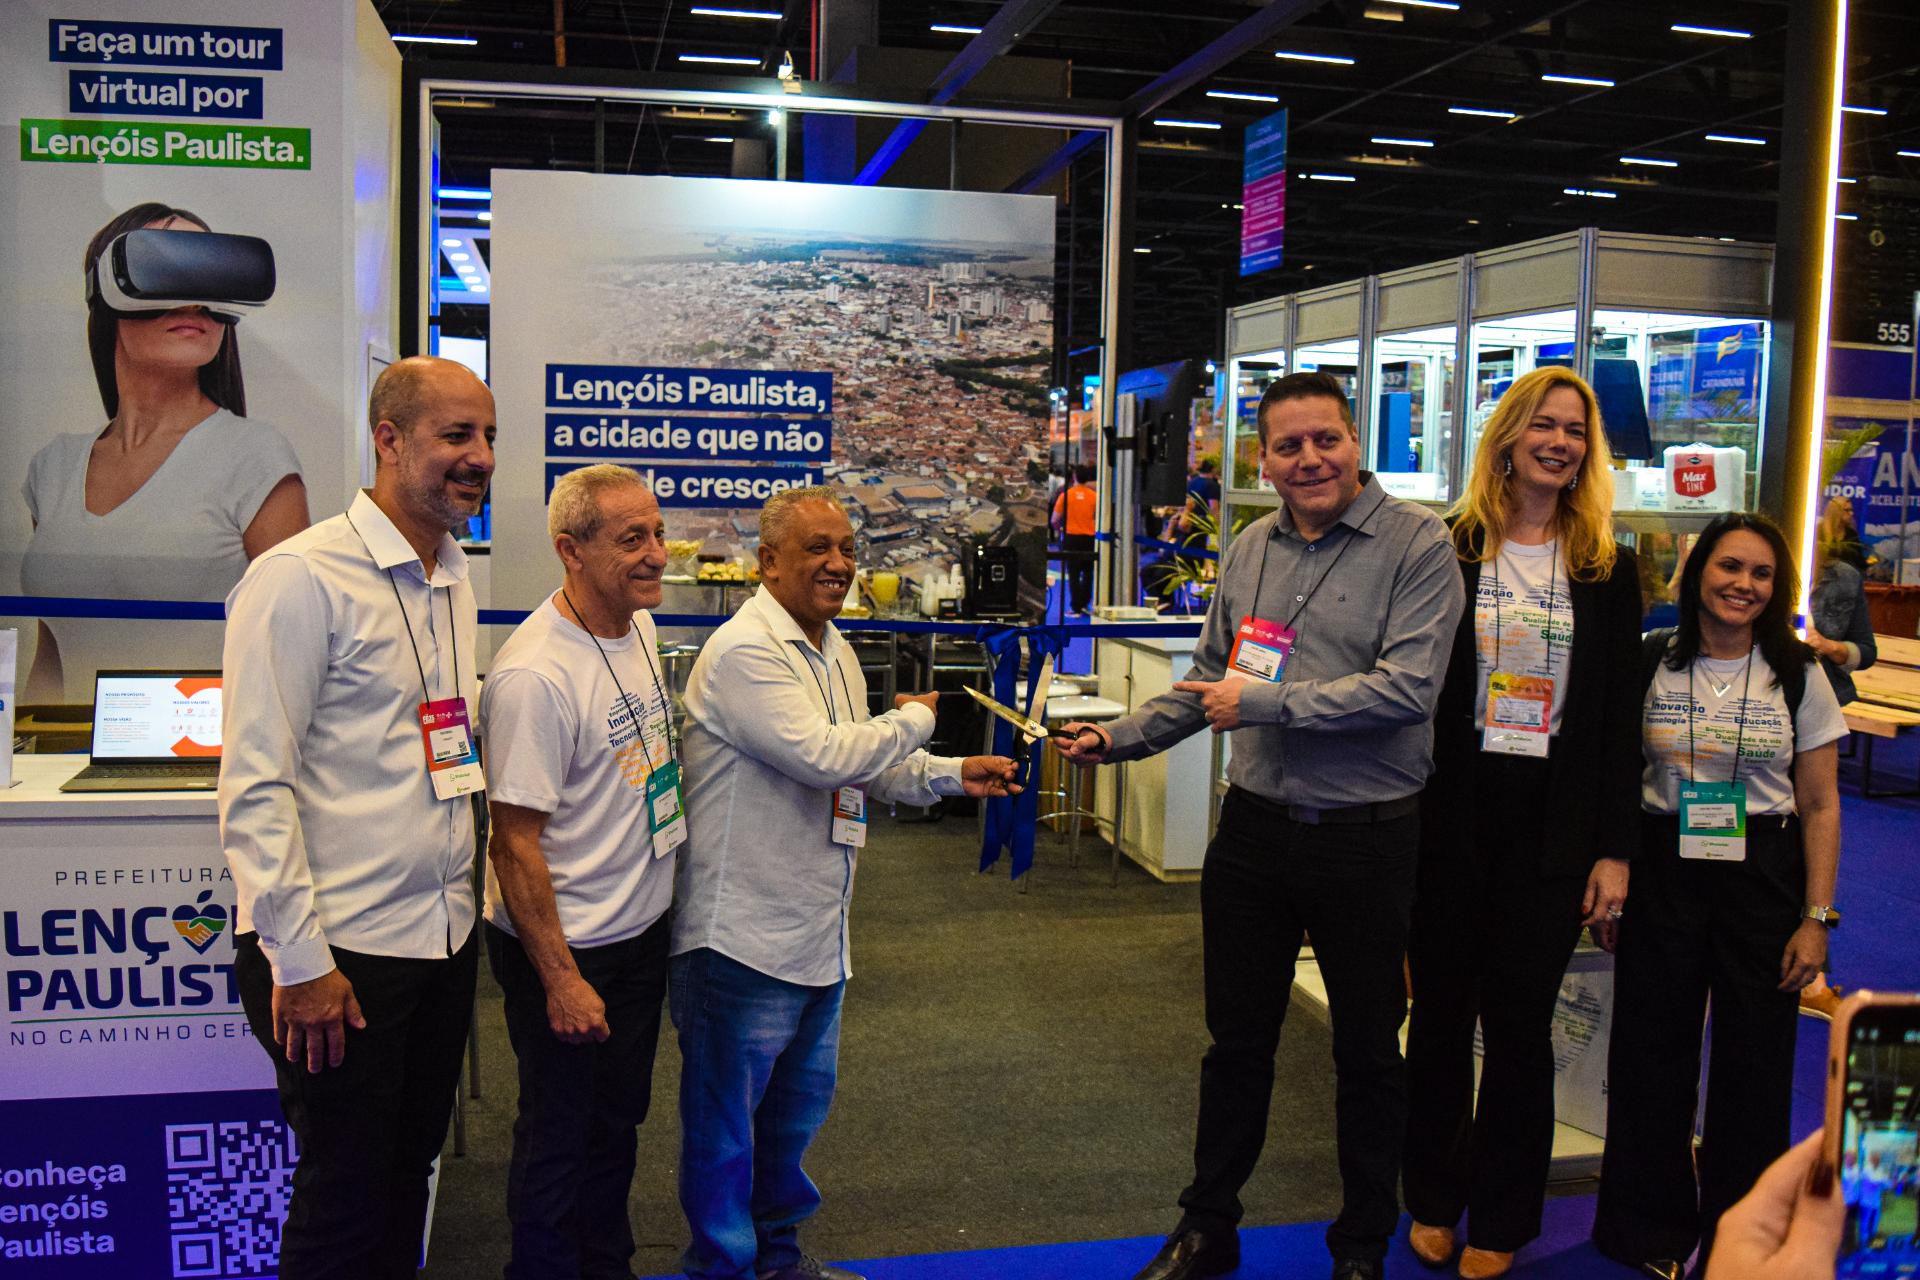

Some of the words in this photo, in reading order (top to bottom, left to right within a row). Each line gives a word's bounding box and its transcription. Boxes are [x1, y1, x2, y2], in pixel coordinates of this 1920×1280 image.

[58, 24, 136, 61] Faça
[143, 34, 194, 56] um
[200, 31, 270, 59] tour
[79, 75, 186, 106] virtual
[193, 86, 249, 112] por
[30, 127, 159, 163] Lençóis
[165, 131, 304, 163] Paulista.
[1878, 323, 1910, 343] 555
[1651, 371, 1684, 383] CELENTE
[555, 372, 683, 409] Lençóis
[688, 375, 826, 412] Paulista,
[554, 425, 573, 447] a
[579, 419, 691, 449] cidade
[697, 429, 758, 455] que
[765, 423, 824, 452] não
[1682, 472, 1707, 484] Max
[1476, 587, 1513, 599] vação
[1522, 616, 1560, 626] Qualidde
[1540, 629, 1572, 642] Saúd
[1737, 746, 1776, 758] Saúde
[55, 867, 234, 886] PREFEITURA
[7, 964, 241, 1012] PAULIST
[11, 1031, 46, 1045] NO
[59, 1025, 190, 1044] CAMINHO
[204, 1023, 254, 1038] CER
[0, 1161, 126, 1190] onheça
[0, 1194, 108, 1228] ençóis
[0, 1231, 115, 1258] aulista
